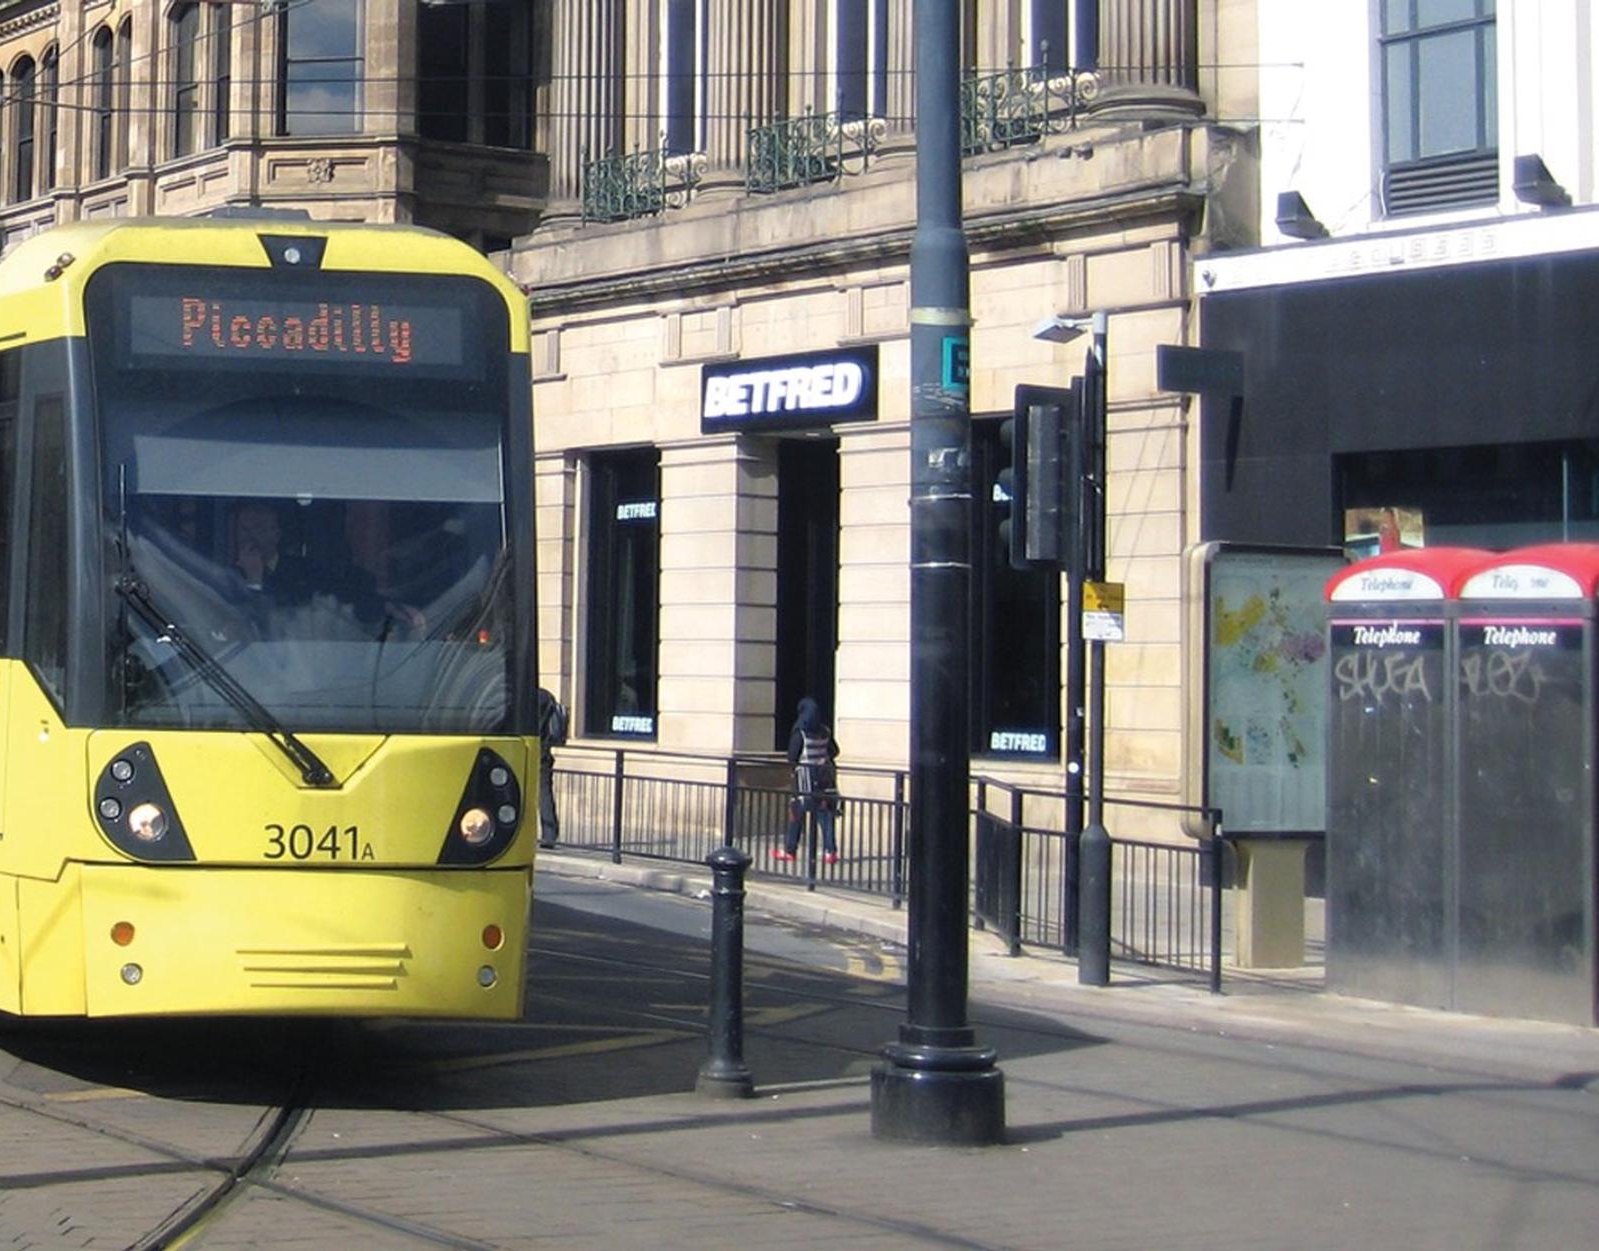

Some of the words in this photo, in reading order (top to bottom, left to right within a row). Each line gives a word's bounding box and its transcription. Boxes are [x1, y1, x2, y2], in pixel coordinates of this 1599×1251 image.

[183, 298, 411, 363] Piccadilly
[704, 362, 862, 418] BETFRED
[1354, 624, 1420, 647] Telephone
[1484, 626, 1556, 649] Telephone
[991, 732, 1047, 752] BETFRED
